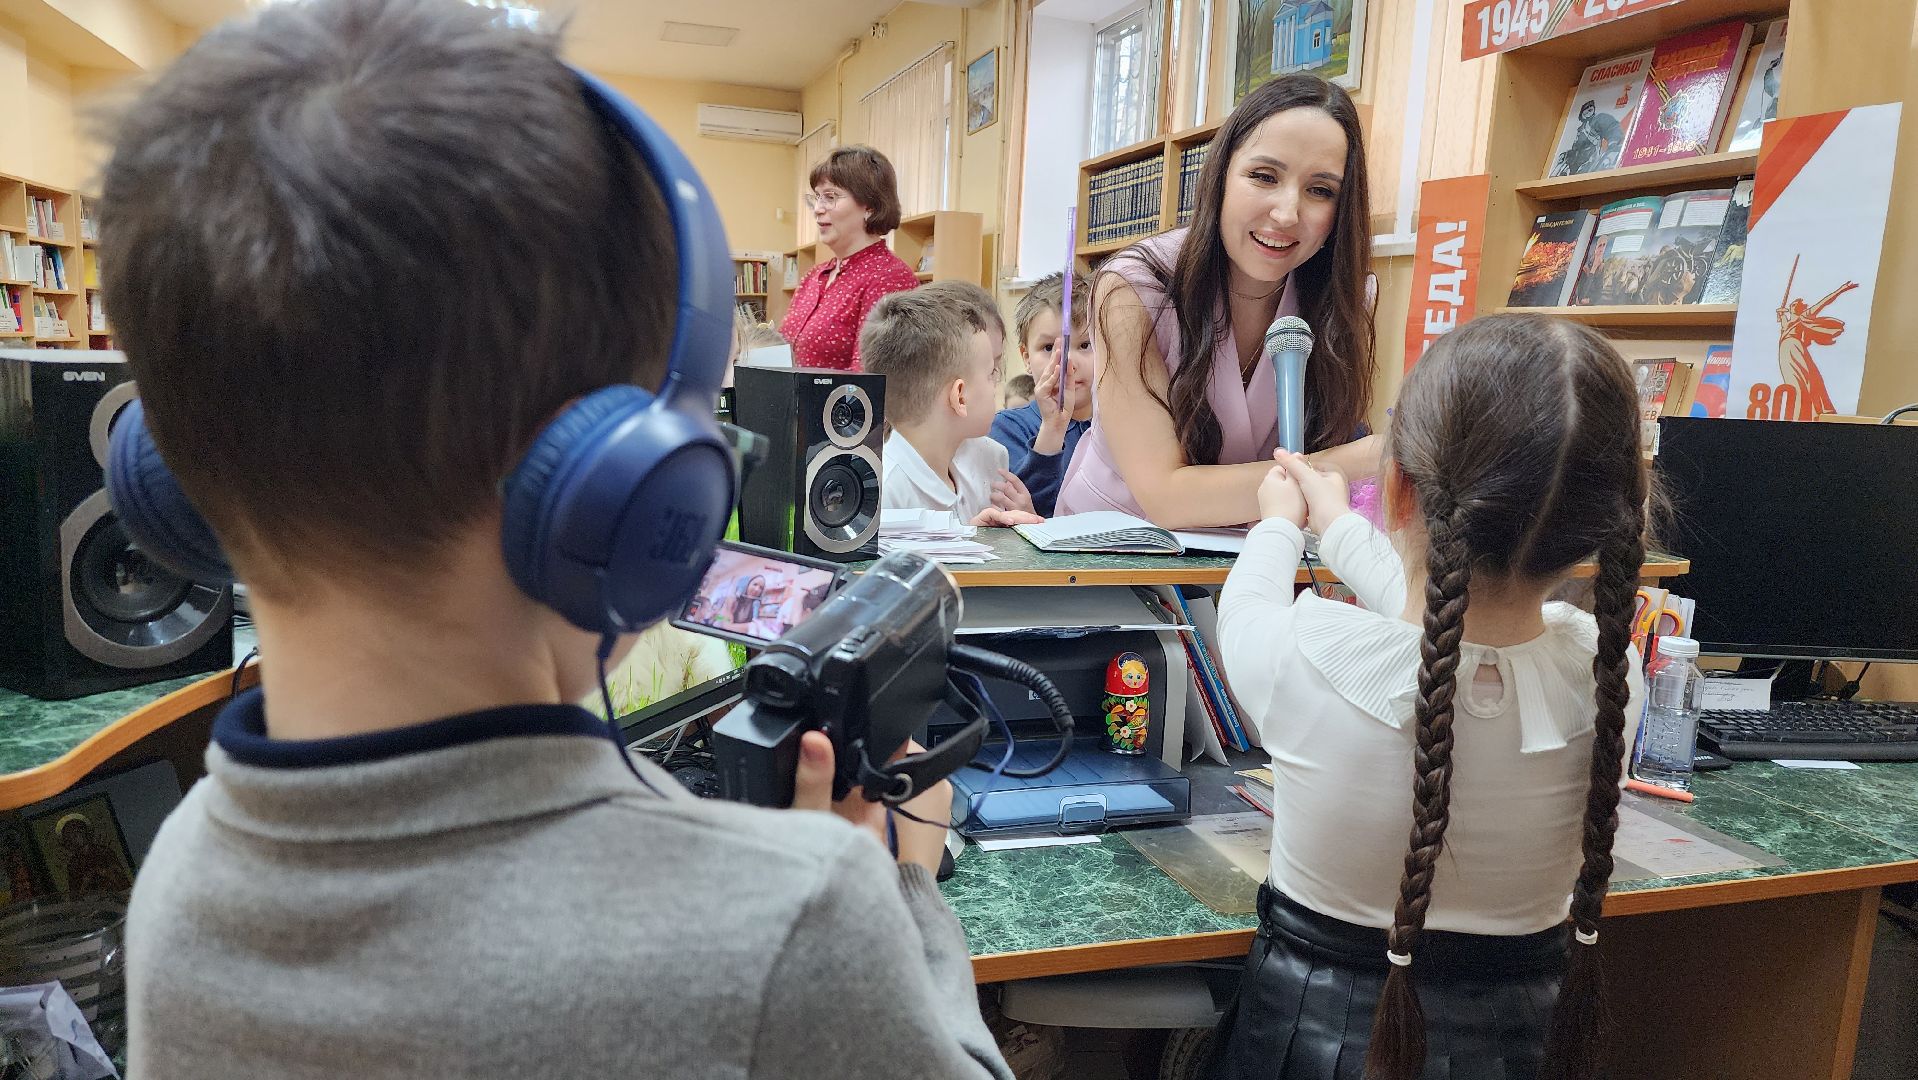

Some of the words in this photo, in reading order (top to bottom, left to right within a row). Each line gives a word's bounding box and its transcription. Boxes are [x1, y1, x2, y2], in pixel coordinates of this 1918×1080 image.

[1477, 0, 1550, 50] 1945
[1590, 58, 1643, 82] СПАСИБО!
[1423, 220, 1468, 353] ЕДА!
[63, 371, 106, 383] SVEN
[1746, 383, 1797, 421] 80
